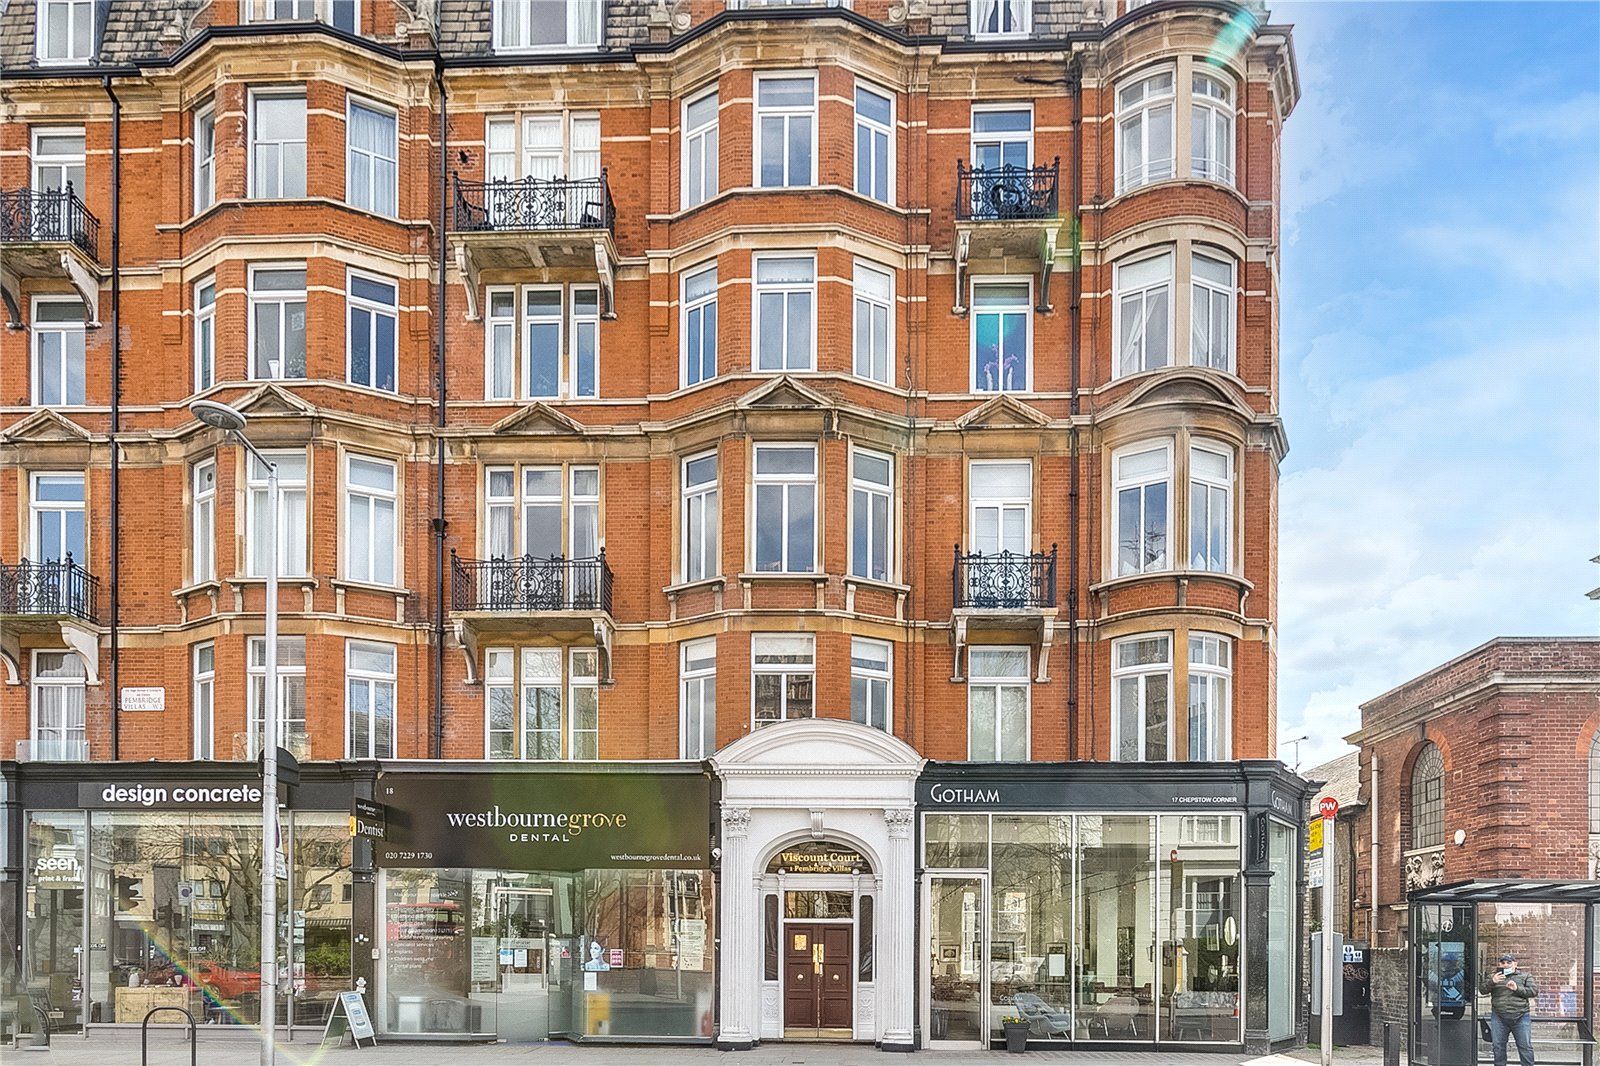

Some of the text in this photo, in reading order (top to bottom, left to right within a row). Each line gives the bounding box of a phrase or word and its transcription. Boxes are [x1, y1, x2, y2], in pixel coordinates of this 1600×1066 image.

[102, 784, 261, 806] design concrete
[386, 787, 394, 795] 18
[930, 783, 1000, 803] GOTHAM
[1320, 802, 1336, 811] PW
[446, 806, 627, 835] westbournegrove
[357, 820, 384, 837] Dentist
[509, 834, 570, 842] DENTAL
[610, 853, 701, 862] westbournegrovedental.co.uk
[781, 852, 860, 862] Viscount Court
[37, 858, 79, 870] seen
